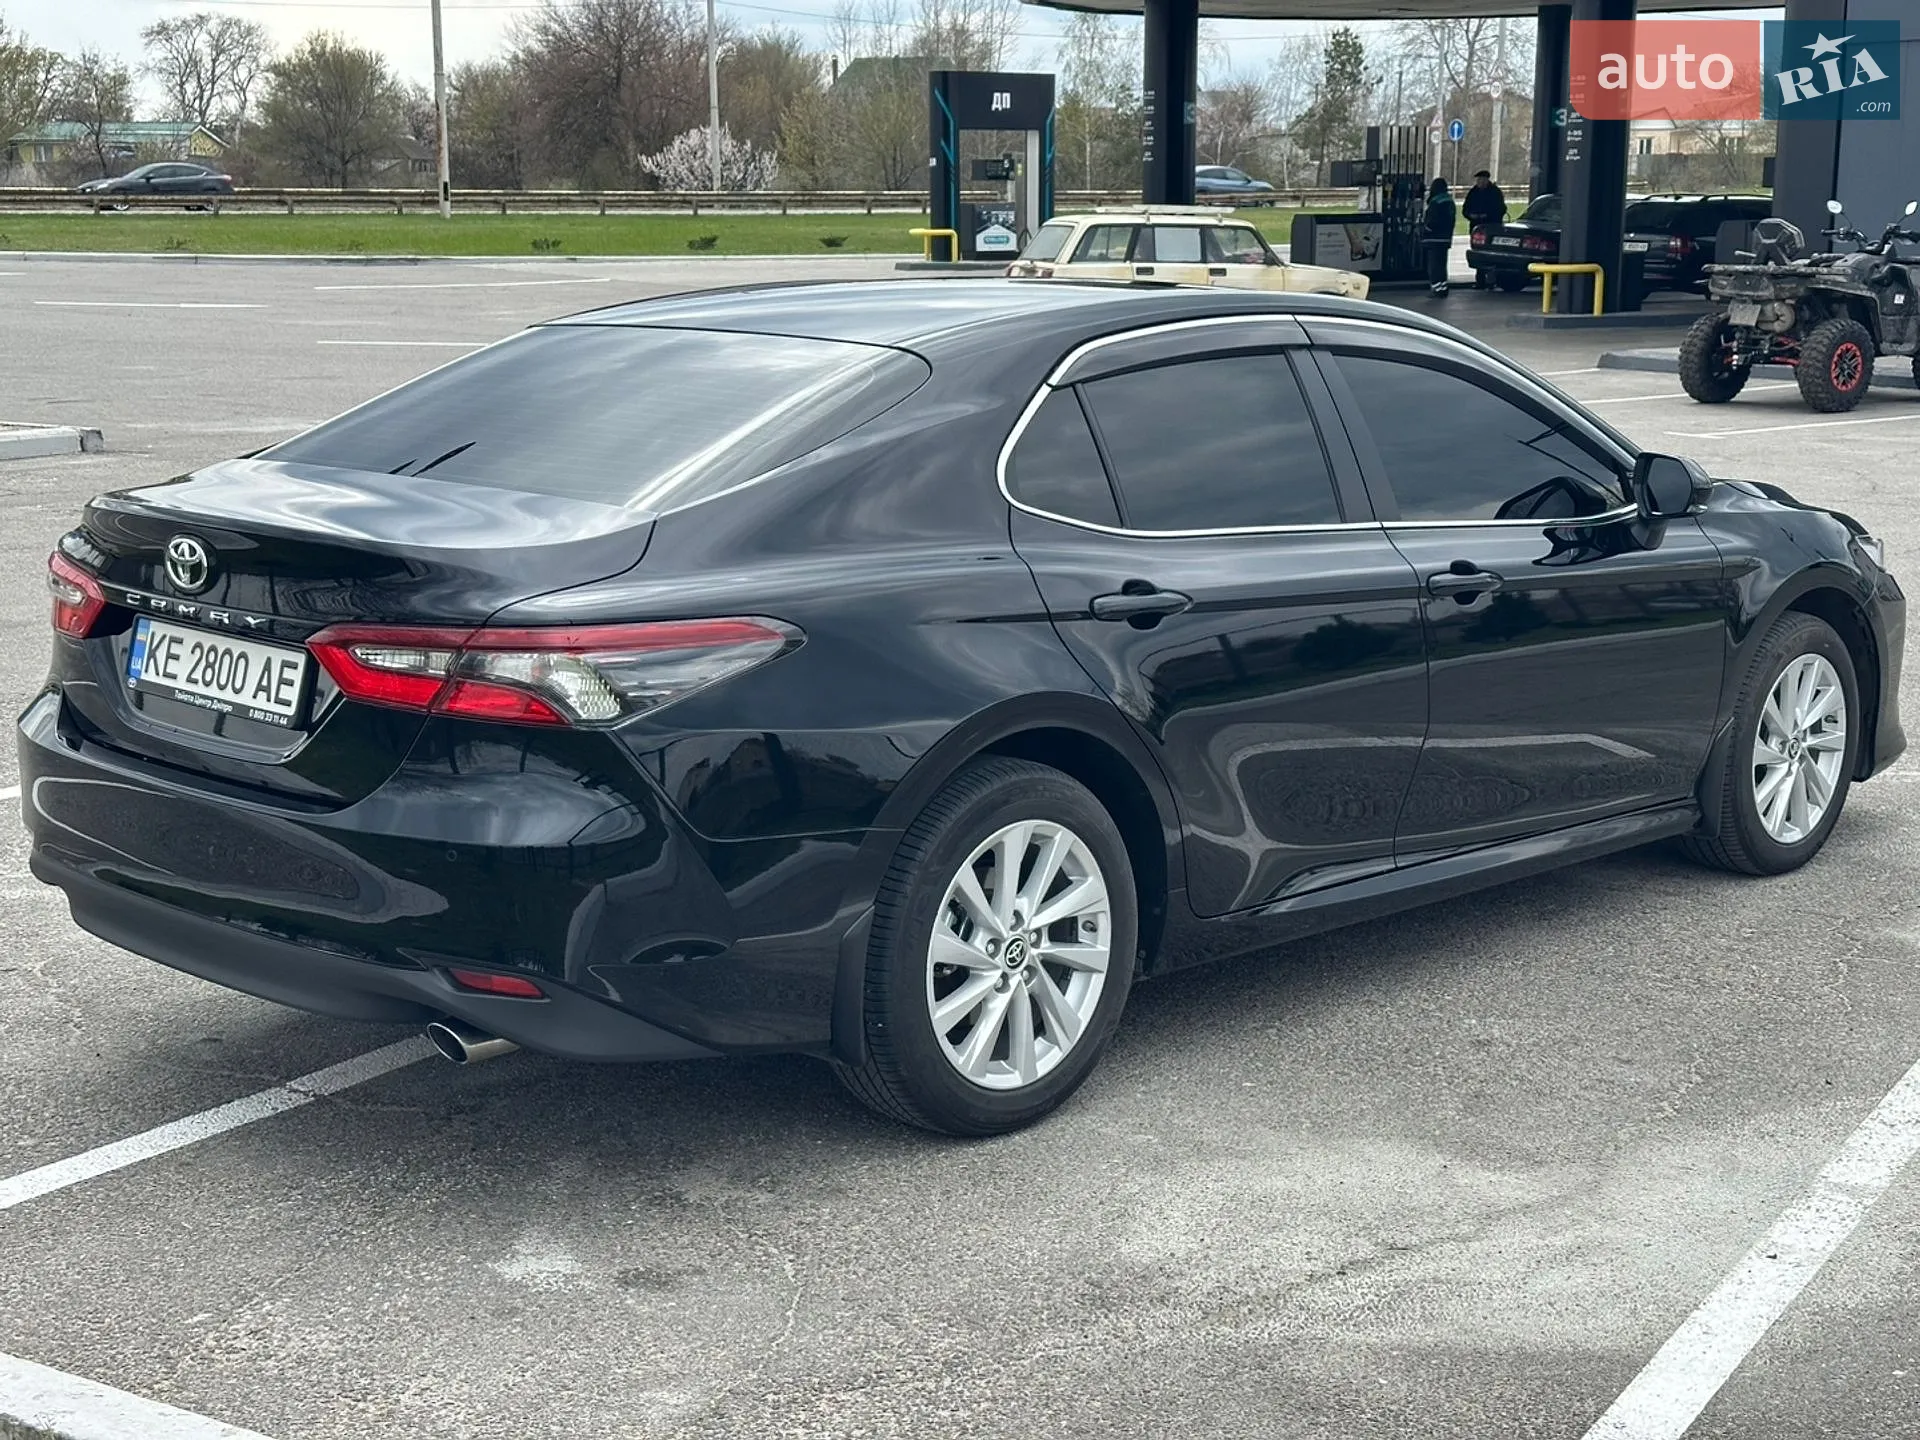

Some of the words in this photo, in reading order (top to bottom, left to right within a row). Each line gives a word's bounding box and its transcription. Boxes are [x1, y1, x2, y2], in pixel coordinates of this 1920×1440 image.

[991, 91, 1011, 111] ДП
[125, 593, 267, 629] CAMRY
[144, 631, 184, 680] KE
[186, 641, 250, 695] 2800
[252, 656, 299, 707] AE
